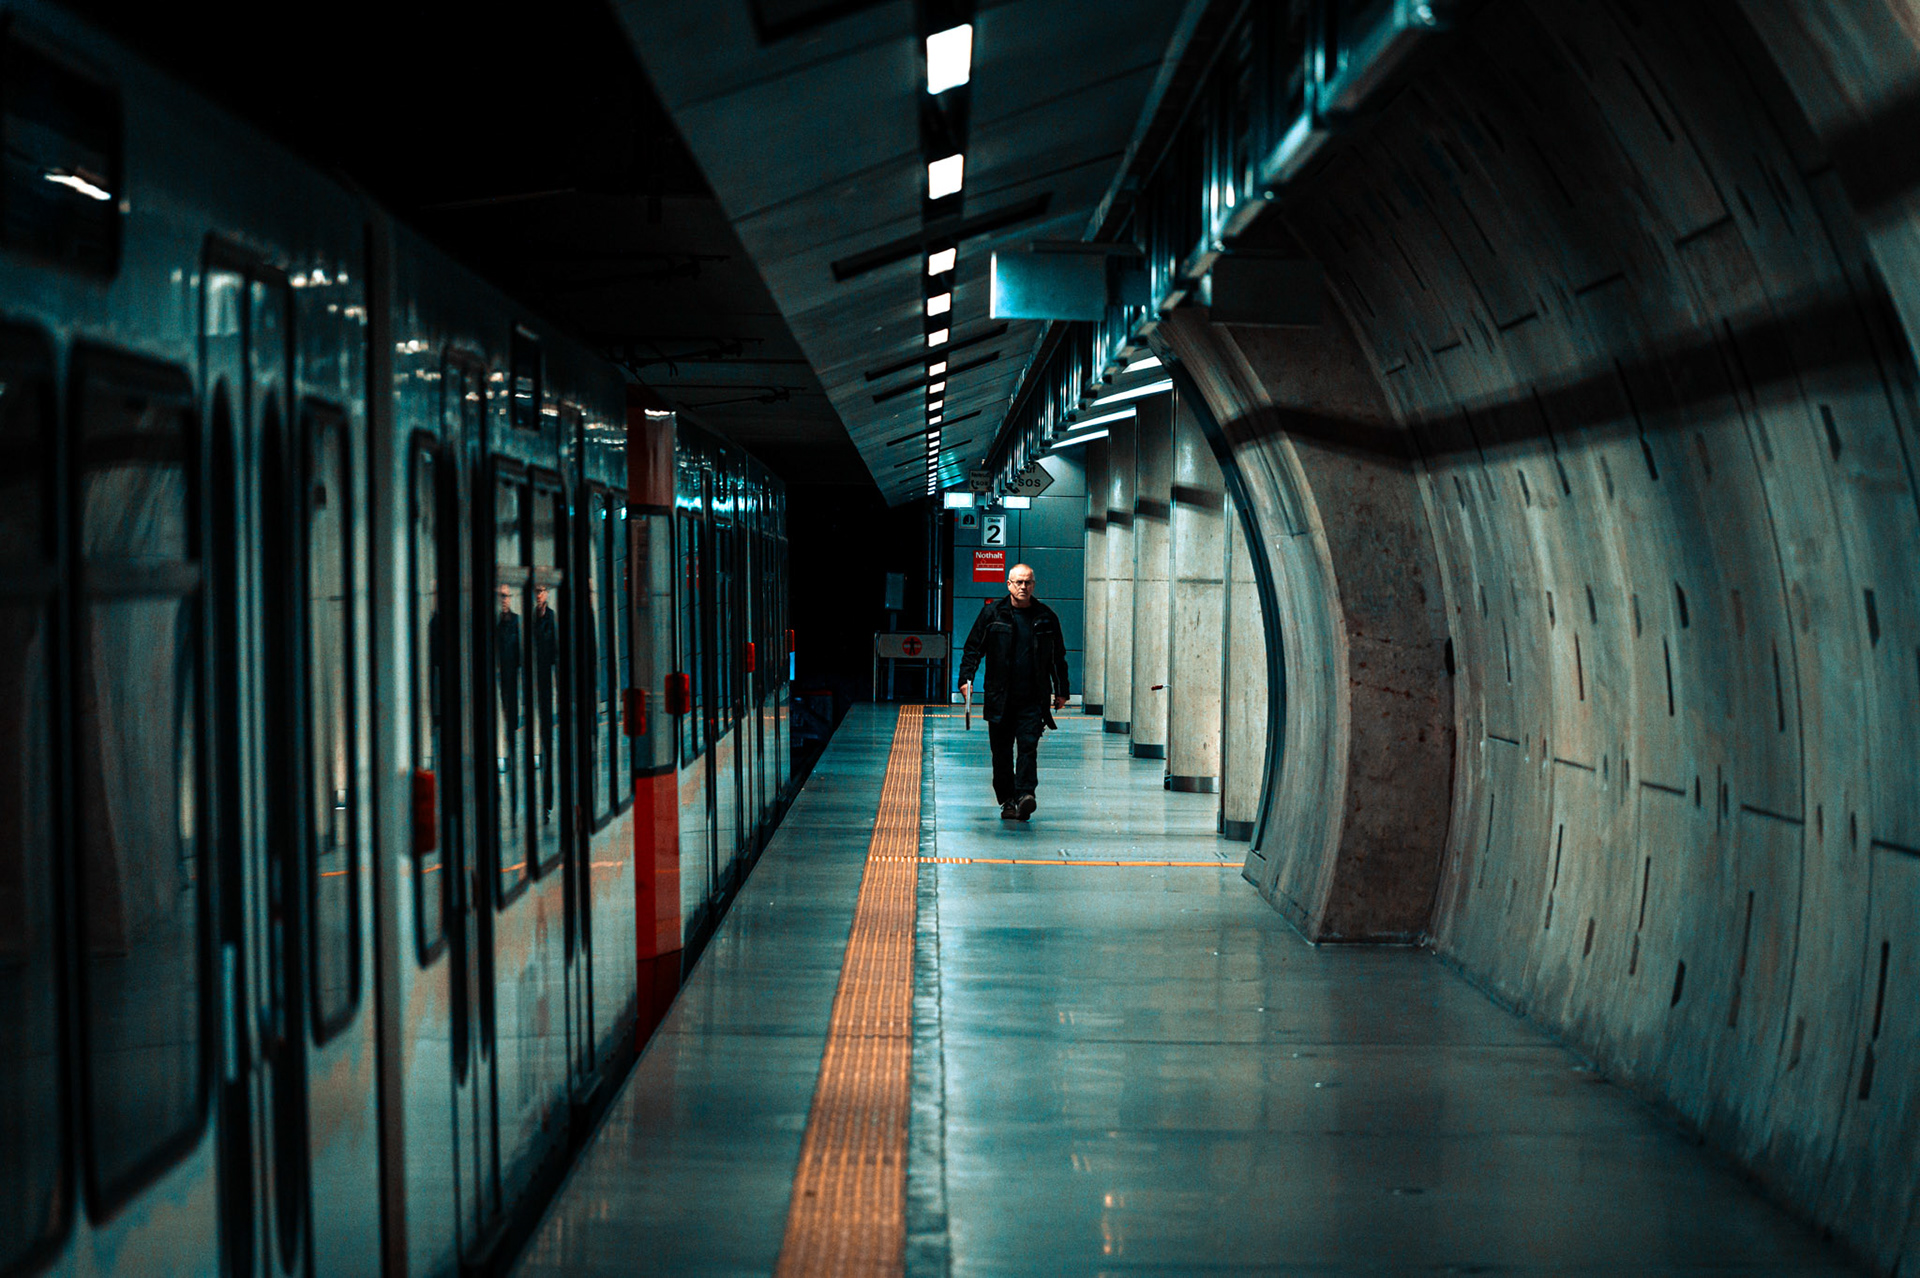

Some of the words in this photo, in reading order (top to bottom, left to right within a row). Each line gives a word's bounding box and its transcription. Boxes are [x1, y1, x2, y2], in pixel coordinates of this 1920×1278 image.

[1018, 478, 1041, 487] SOS
[987, 525, 1001, 543] 2
[975, 551, 1003, 559] Nothalt
